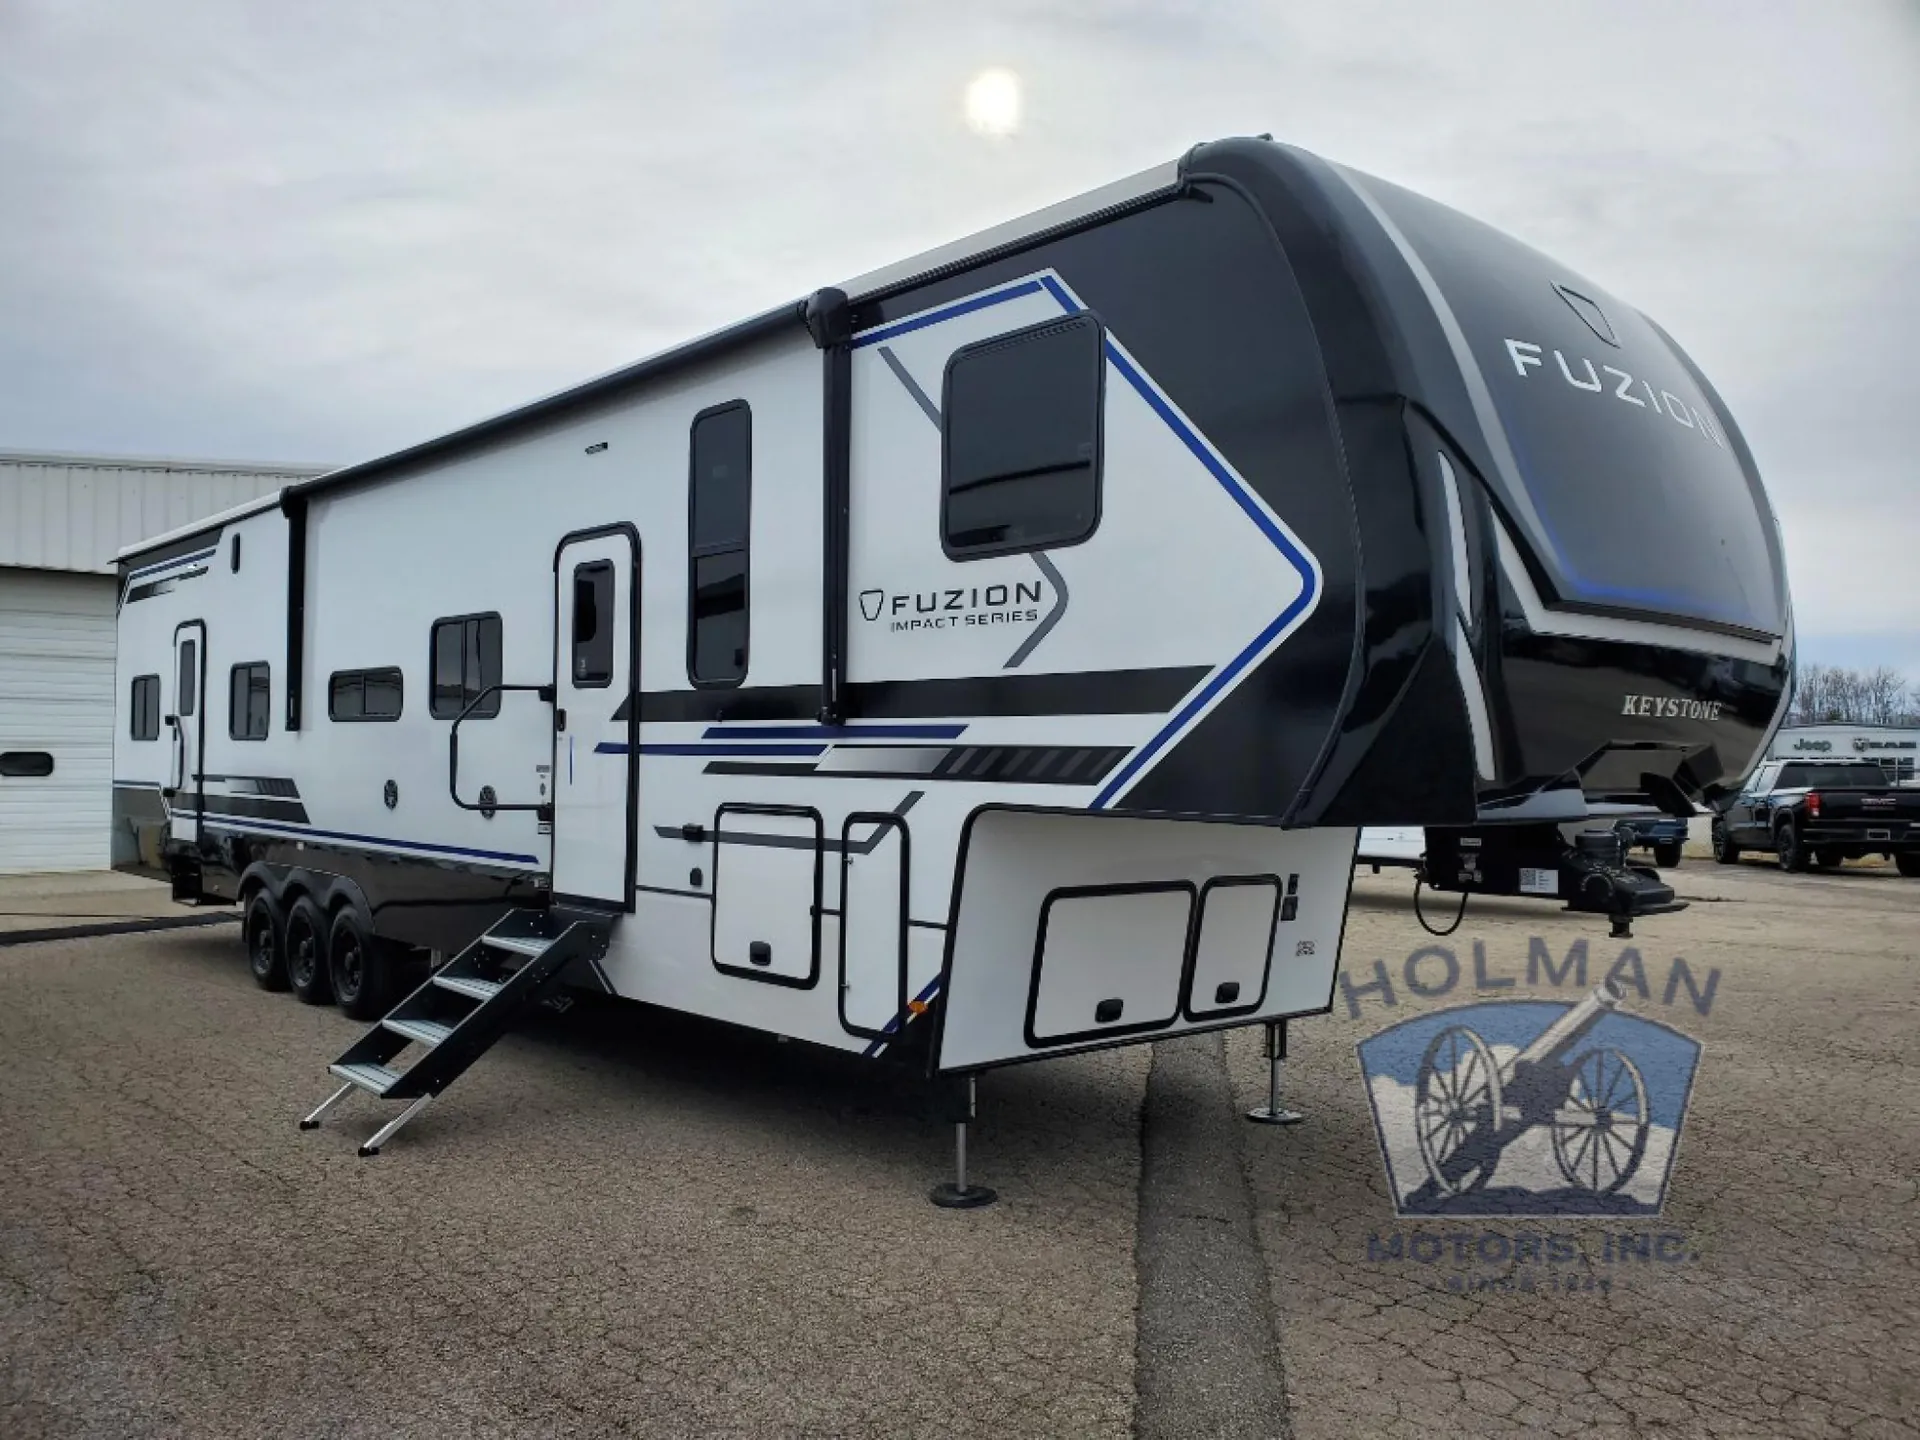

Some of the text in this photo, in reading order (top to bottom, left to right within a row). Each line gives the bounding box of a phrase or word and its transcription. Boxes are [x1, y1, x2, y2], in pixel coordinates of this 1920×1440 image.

[1504, 338, 1724, 449] FUZION
[892, 581, 1041, 615] FUZION
[891, 609, 1038, 632] IMPACT SERIES
[1621, 695, 1721, 720] KEYSTONE
[1793, 738, 1832, 752] Jeep
